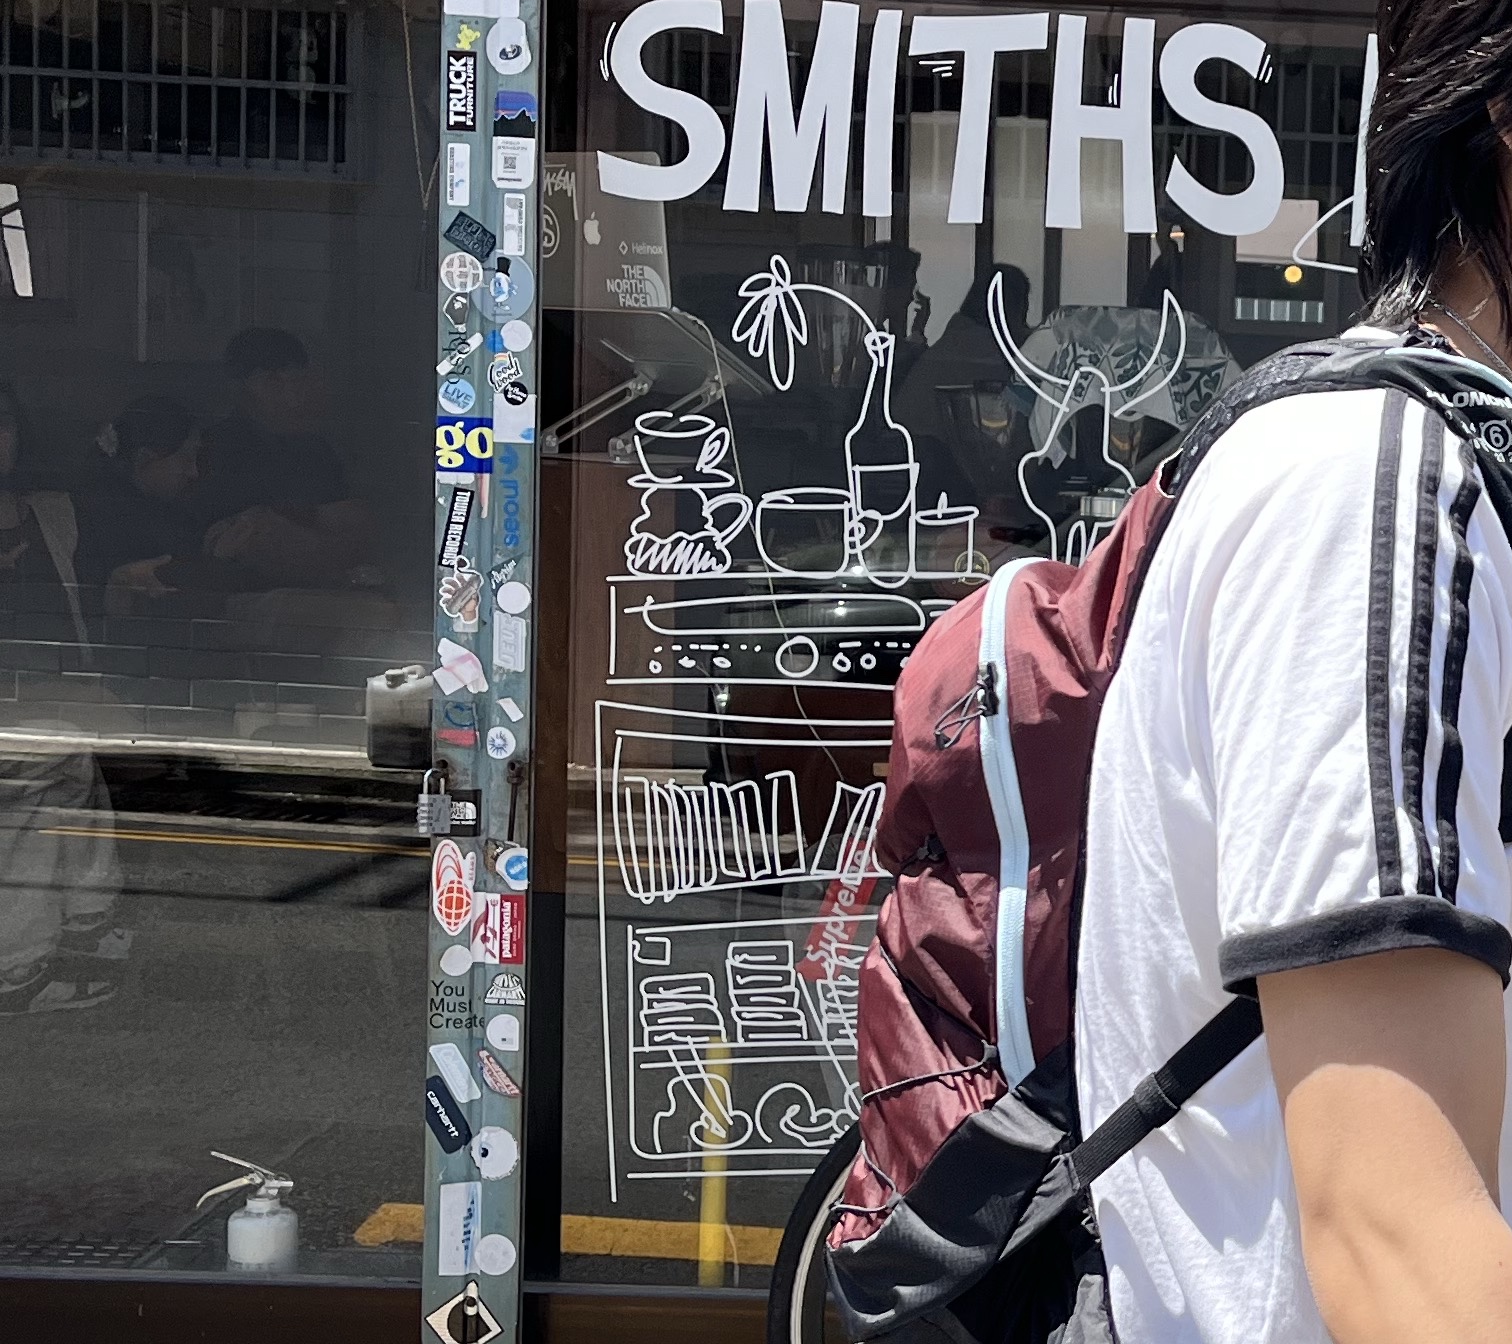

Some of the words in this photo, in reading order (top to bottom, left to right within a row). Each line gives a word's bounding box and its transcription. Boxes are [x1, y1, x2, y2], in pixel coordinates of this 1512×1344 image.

[449, 56, 466, 127] TRUCK
[466, 56, 475, 127] FURNITURE
[632, 242, 664, 255] Helinox
[622, 265, 644, 278] THE
[606, 279, 645, 293] NORTH
[619, 294, 647, 307] FACE
[444, 385, 473, 401] LIVE
[436, 421, 493, 468] go
[1490, 426, 1504, 447] 6
[451, 491, 471, 523] TOWER
[441, 524, 463, 565] RECORDS
[502, 901, 512, 958] patagonia
[431, 980, 465, 997] You
[430, 998, 473, 1013] Must
[430, 1013, 485, 1029] Create
[427, 1090, 459, 1137] carhartt
